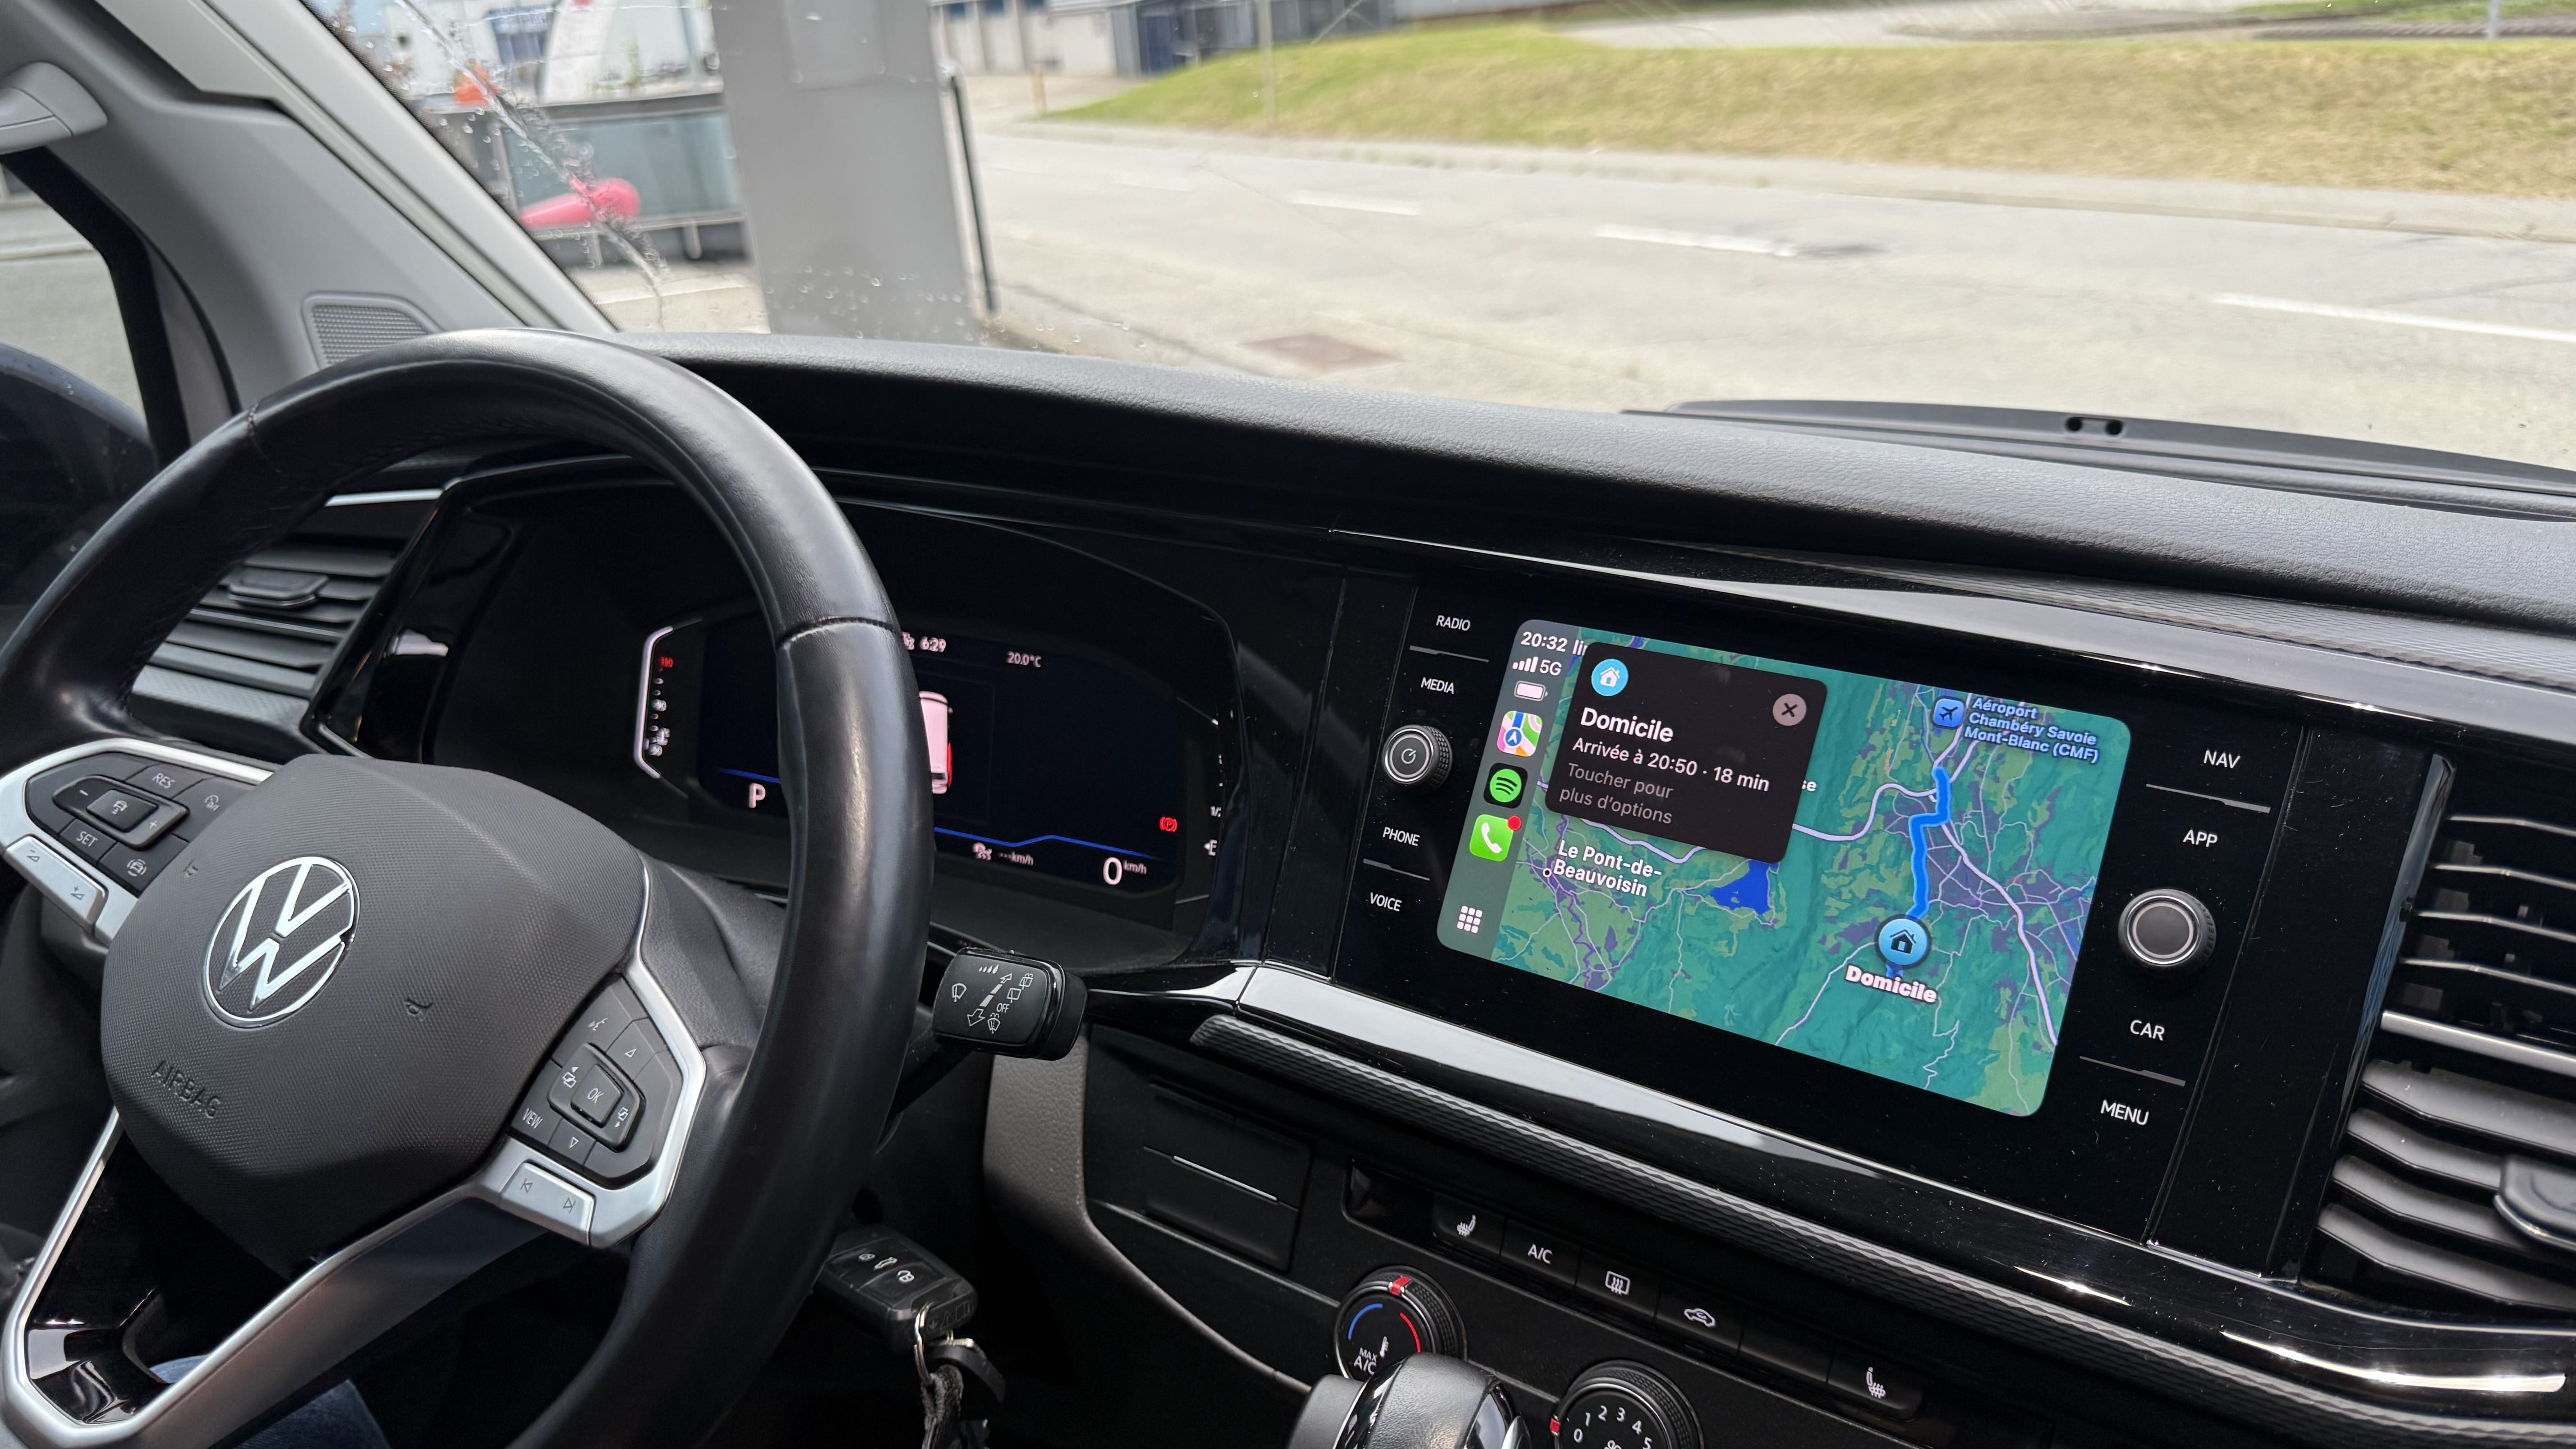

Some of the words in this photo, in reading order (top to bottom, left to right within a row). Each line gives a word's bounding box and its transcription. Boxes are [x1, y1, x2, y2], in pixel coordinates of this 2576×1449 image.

[1436, 615, 1471, 631] RADIO
[919, 636, 947, 653] 6:29
[1521, 631, 1568, 652] 20:32
[1006, 650, 1042, 668] 20.0°C
[1540, 659, 1562, 676] 5G
[1421, 677, 1454, 694] MEDIA
[1972, 698, 2037, 720] Aéroport
[1581, 707, 1674, 742] Domicile
[1969, 713, 2043, 739] Chambéry
[2047, 726, 2097, 746] Savoie
[1964, 726, 2049, 752] Mont-Blanc
[2052, 743, 2100, 764] (CMF)
[1573, 737, 1629, 761] Arrivée
[1633, 748, 1644, 765] à
[1647, 753, 1697, 776] 20:50
[1714, 767, 1733, 783] 18
[1736, 774, 1770, 791] min
[2203, 749, 2240, 768] NAV
[152, 773, 175, 789] RES
[1568, 763, 1630, 789] Toucher
[1633, 780, 1674, 799] pour
[749, 782, 766, 809] P
[1559, 787, 1592, 805] plus
[76, 831, 98, 847] SET
[1383, 827, 1420, 846] PHONE
[2183, 829, 2218, 847] APP
[1558, 839, 1578, 859] Le
[1582, 846, 1662, 878] Pont-de-
[1103, 857, 1122, 885] 0
[1123, 860, 1147, 875] km/h
[1554, 859, 1647, 897] Beauvoisin
[1370, 892, 1402, 912] VOICE
[1845, 965, 1938, 1003] Domicile
[996, 1003, 1010, 1013] OFF
[2130, 1020, 2165, 1041] CAR
[151, 1060, 221, 1119] AIRBAG
[587, 1088, 604, 1104] OK
[523, 1108, 543, 1129] VIEW
[2101, 1099, 2149, 1126] MENU
[1527, 1244, 1553, 1265] A/C
[1359, 1347, 1377, 1362] MAX
[1354, 1356, 1377, 1375] A/C
[1573, 1428, 1583, 1443] 0
[1585, 1412, 1591, 1427] 1
[1598, 1405, 1608, 1421] 2
[1616, 1407, 1626, 1422] 3
[1632, 1420, 1642, 1435] 4
[1642, 1437, 1652, 1449] 5
